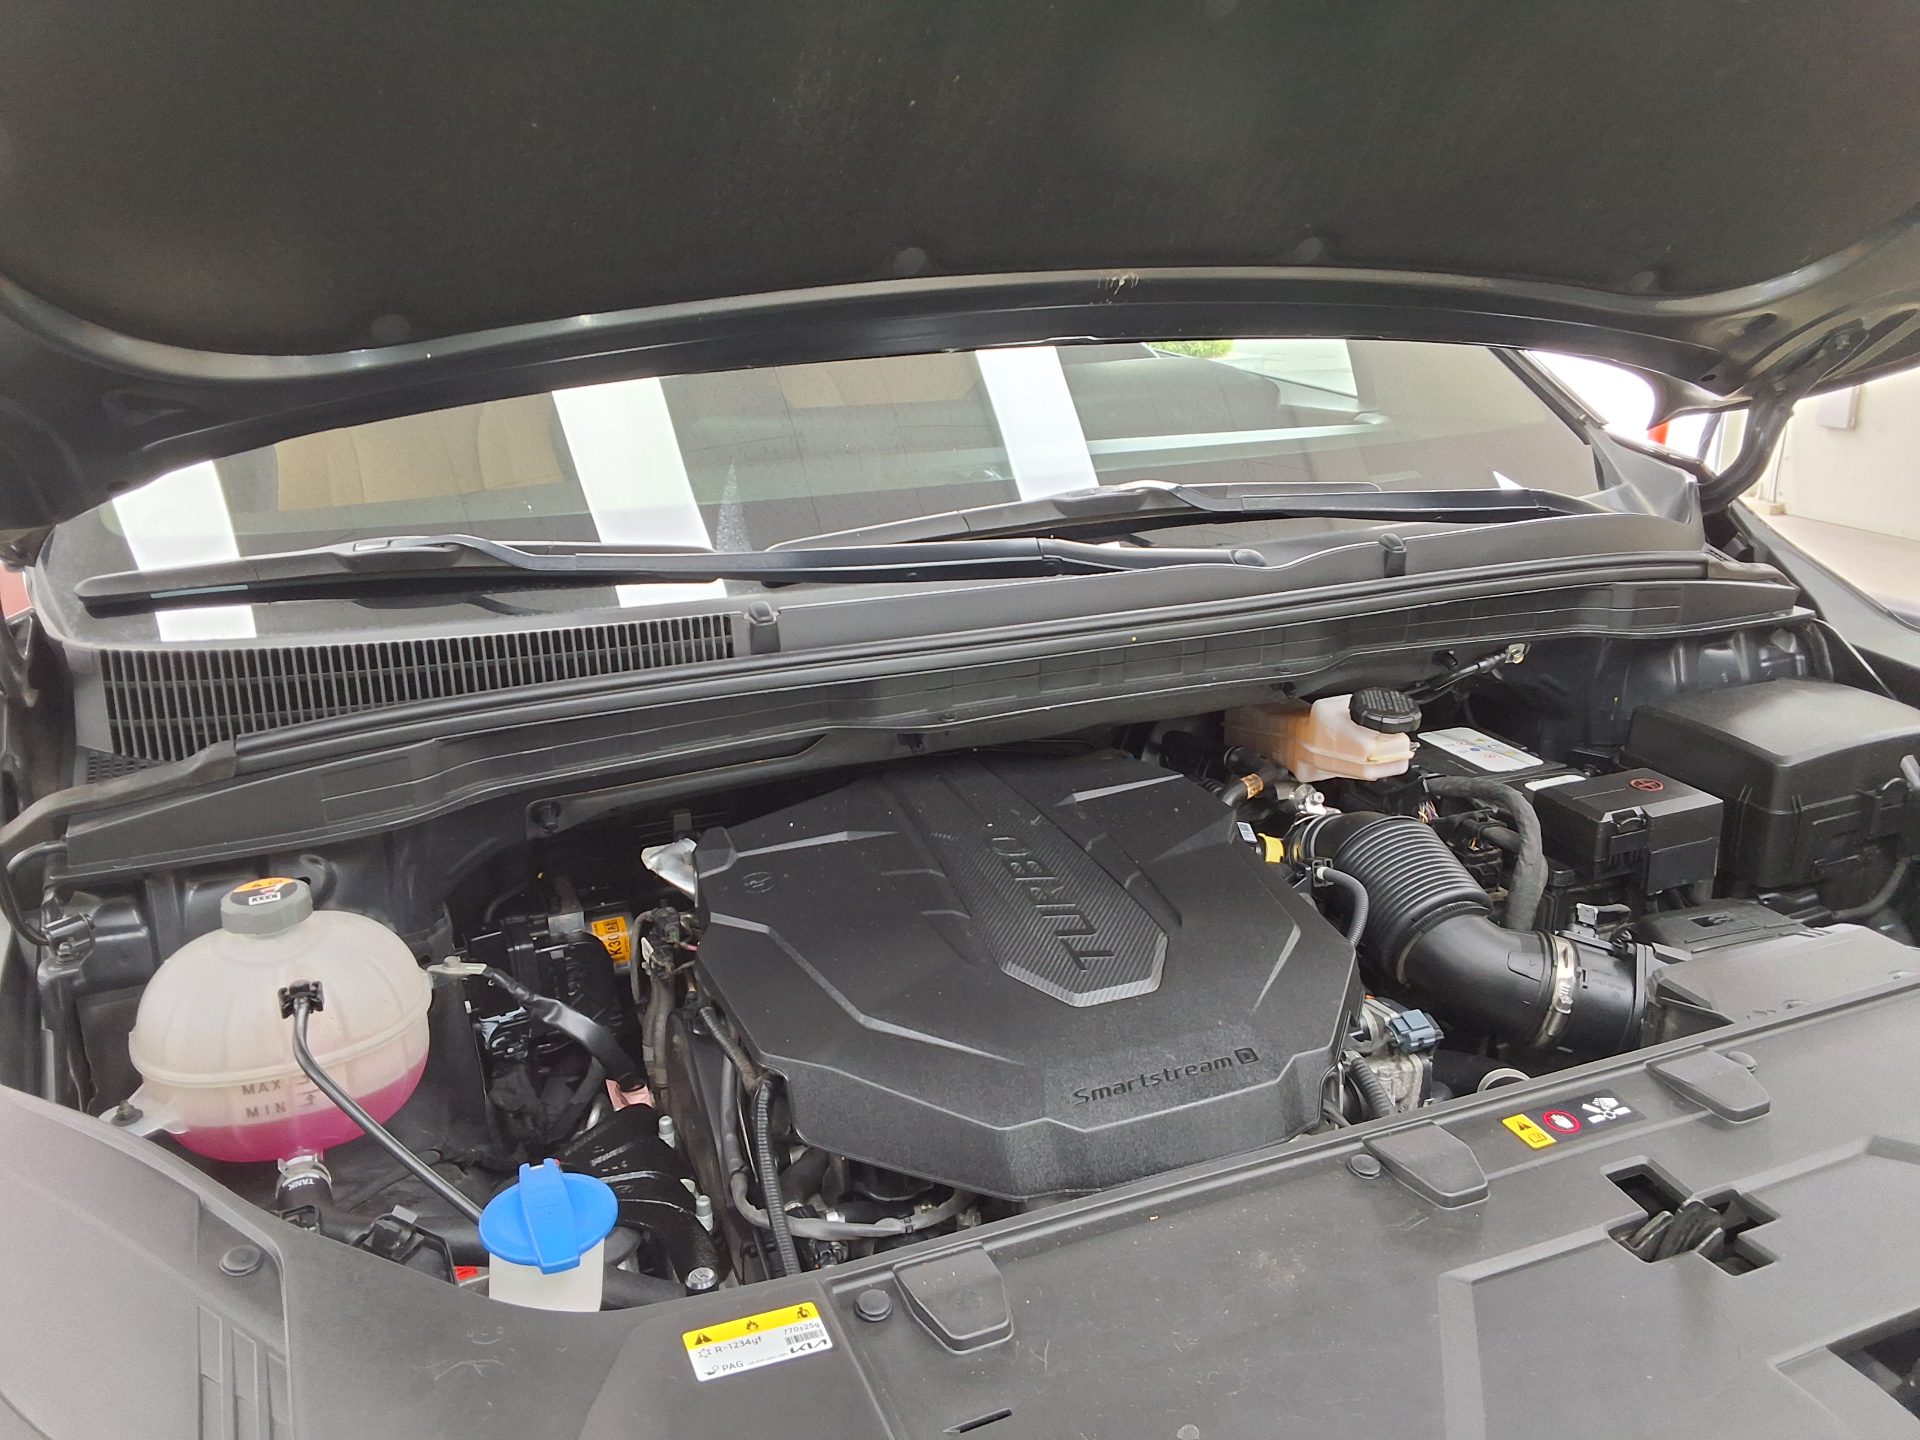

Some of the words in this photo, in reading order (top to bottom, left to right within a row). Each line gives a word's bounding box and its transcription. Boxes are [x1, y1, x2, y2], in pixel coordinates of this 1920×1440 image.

[991, 836, 1115, 972] TURBO
[242, 1079, 281, 1095] MAX
[1073, 1056, 1233, 1108] Smartstream
[246, 1102, 286, 1118] MIN
[288, 1178, 315, 1191] TANK
[715, 1336, 762, 1353] R-1234yf
[790, 1339, 828, 1353] KIA
[722, 1361, 744, 1372] PAG
